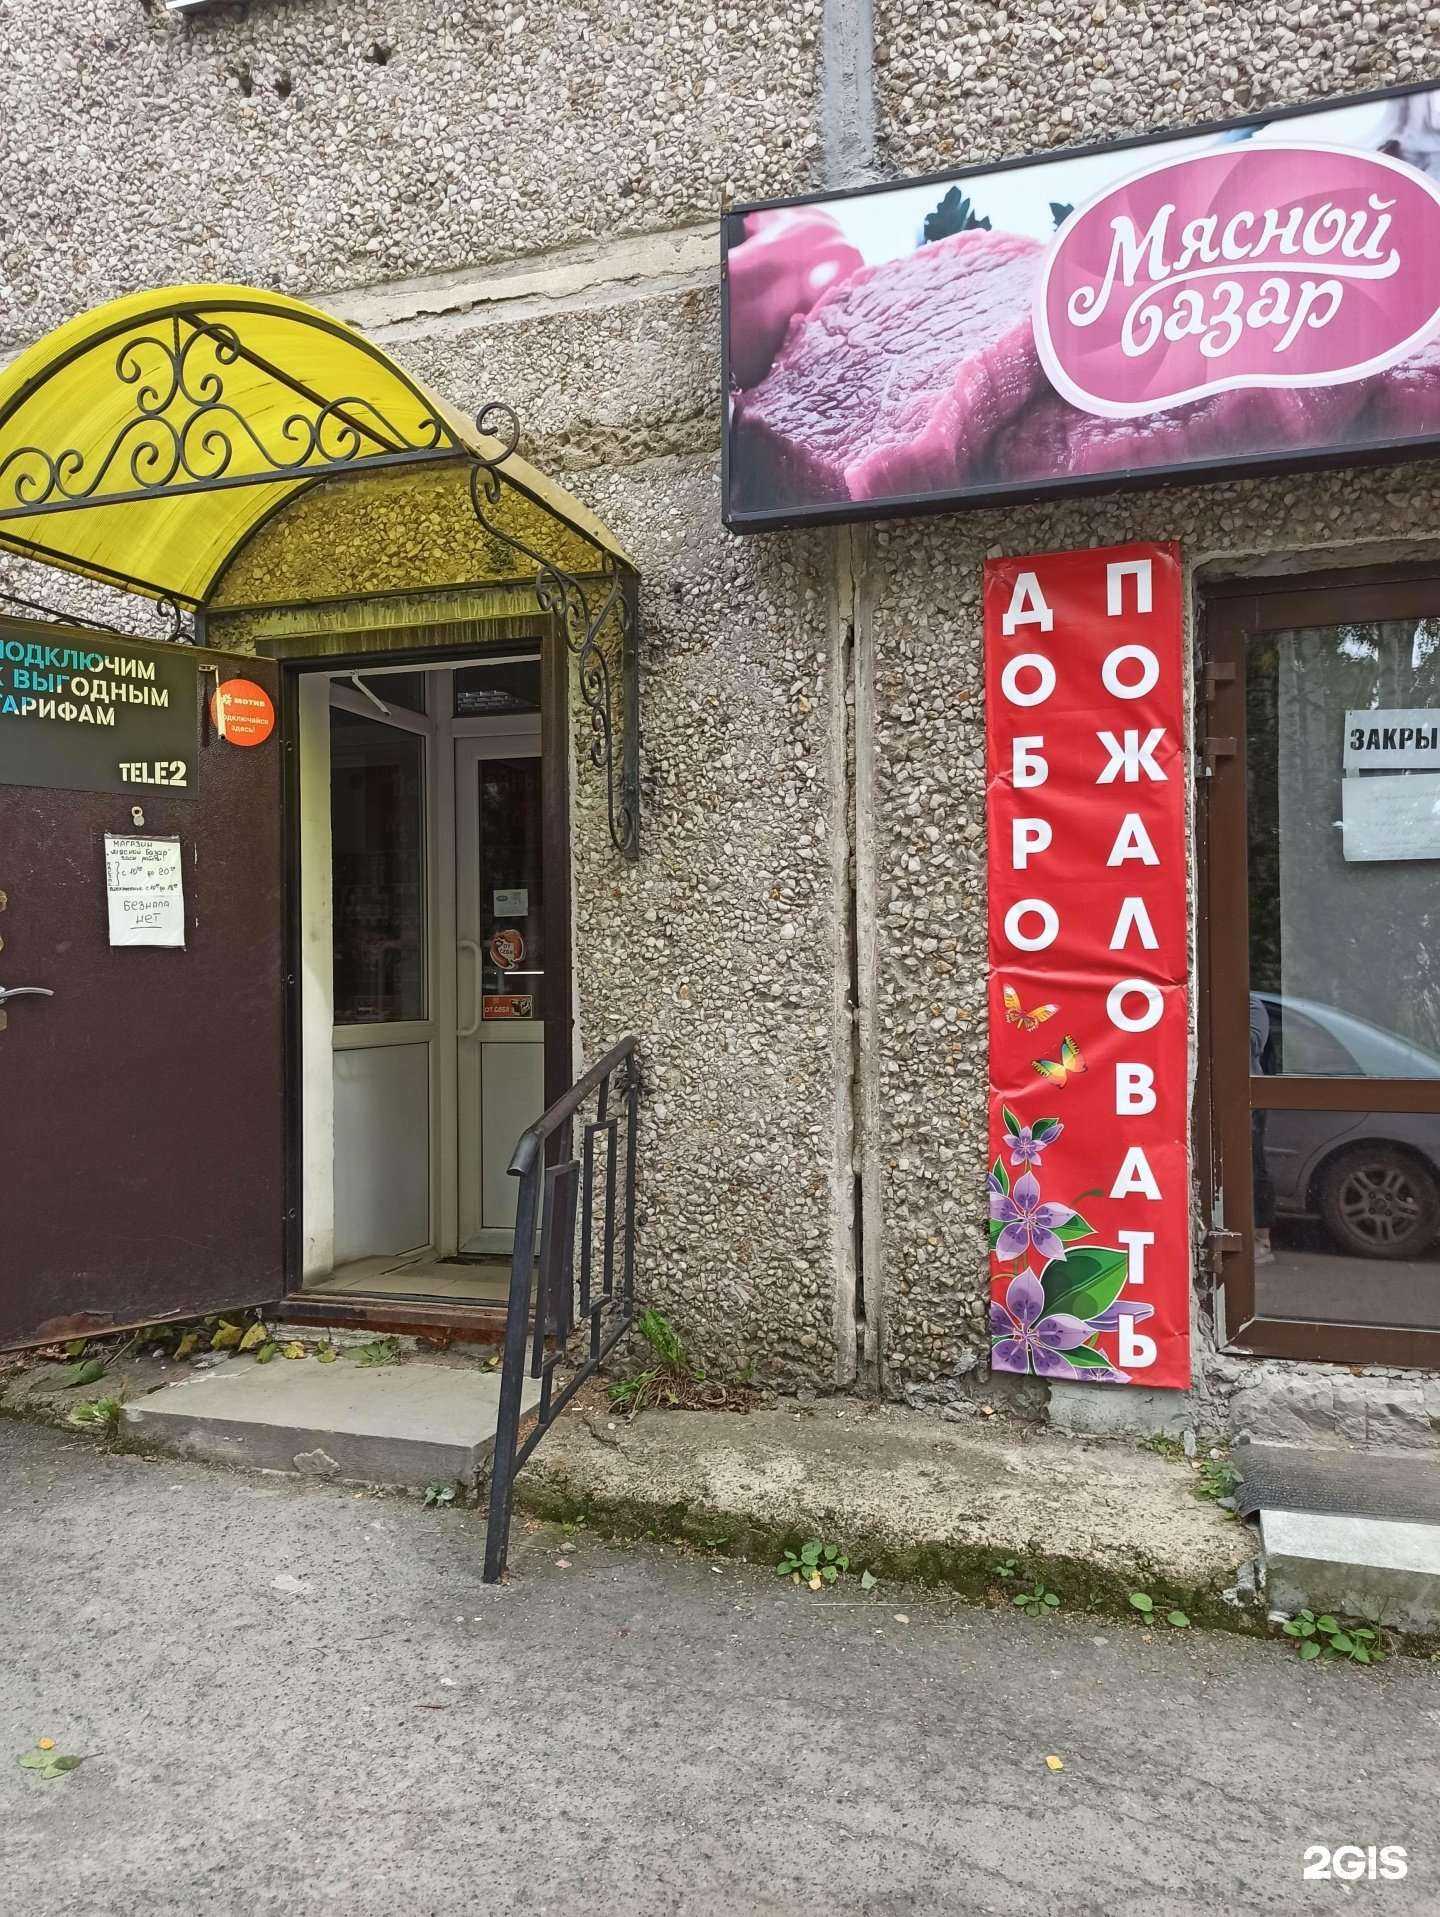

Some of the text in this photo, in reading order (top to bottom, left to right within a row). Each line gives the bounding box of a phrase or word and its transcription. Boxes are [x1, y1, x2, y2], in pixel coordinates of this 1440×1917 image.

[1067, 193, 1397, 327] Мясной
[1121, 252, 1396, 358] базар
[0, 693, 116, 726] АРИФАМ
[13, 668, 169, 708] ВЫГОДНЫМ
[119, 761, 188, 787] TELE2
[1001, 572, 1059, 952] ДОБРО
[1096, 559, 1168, 1367] ПОЖАЛОВАТЬ
